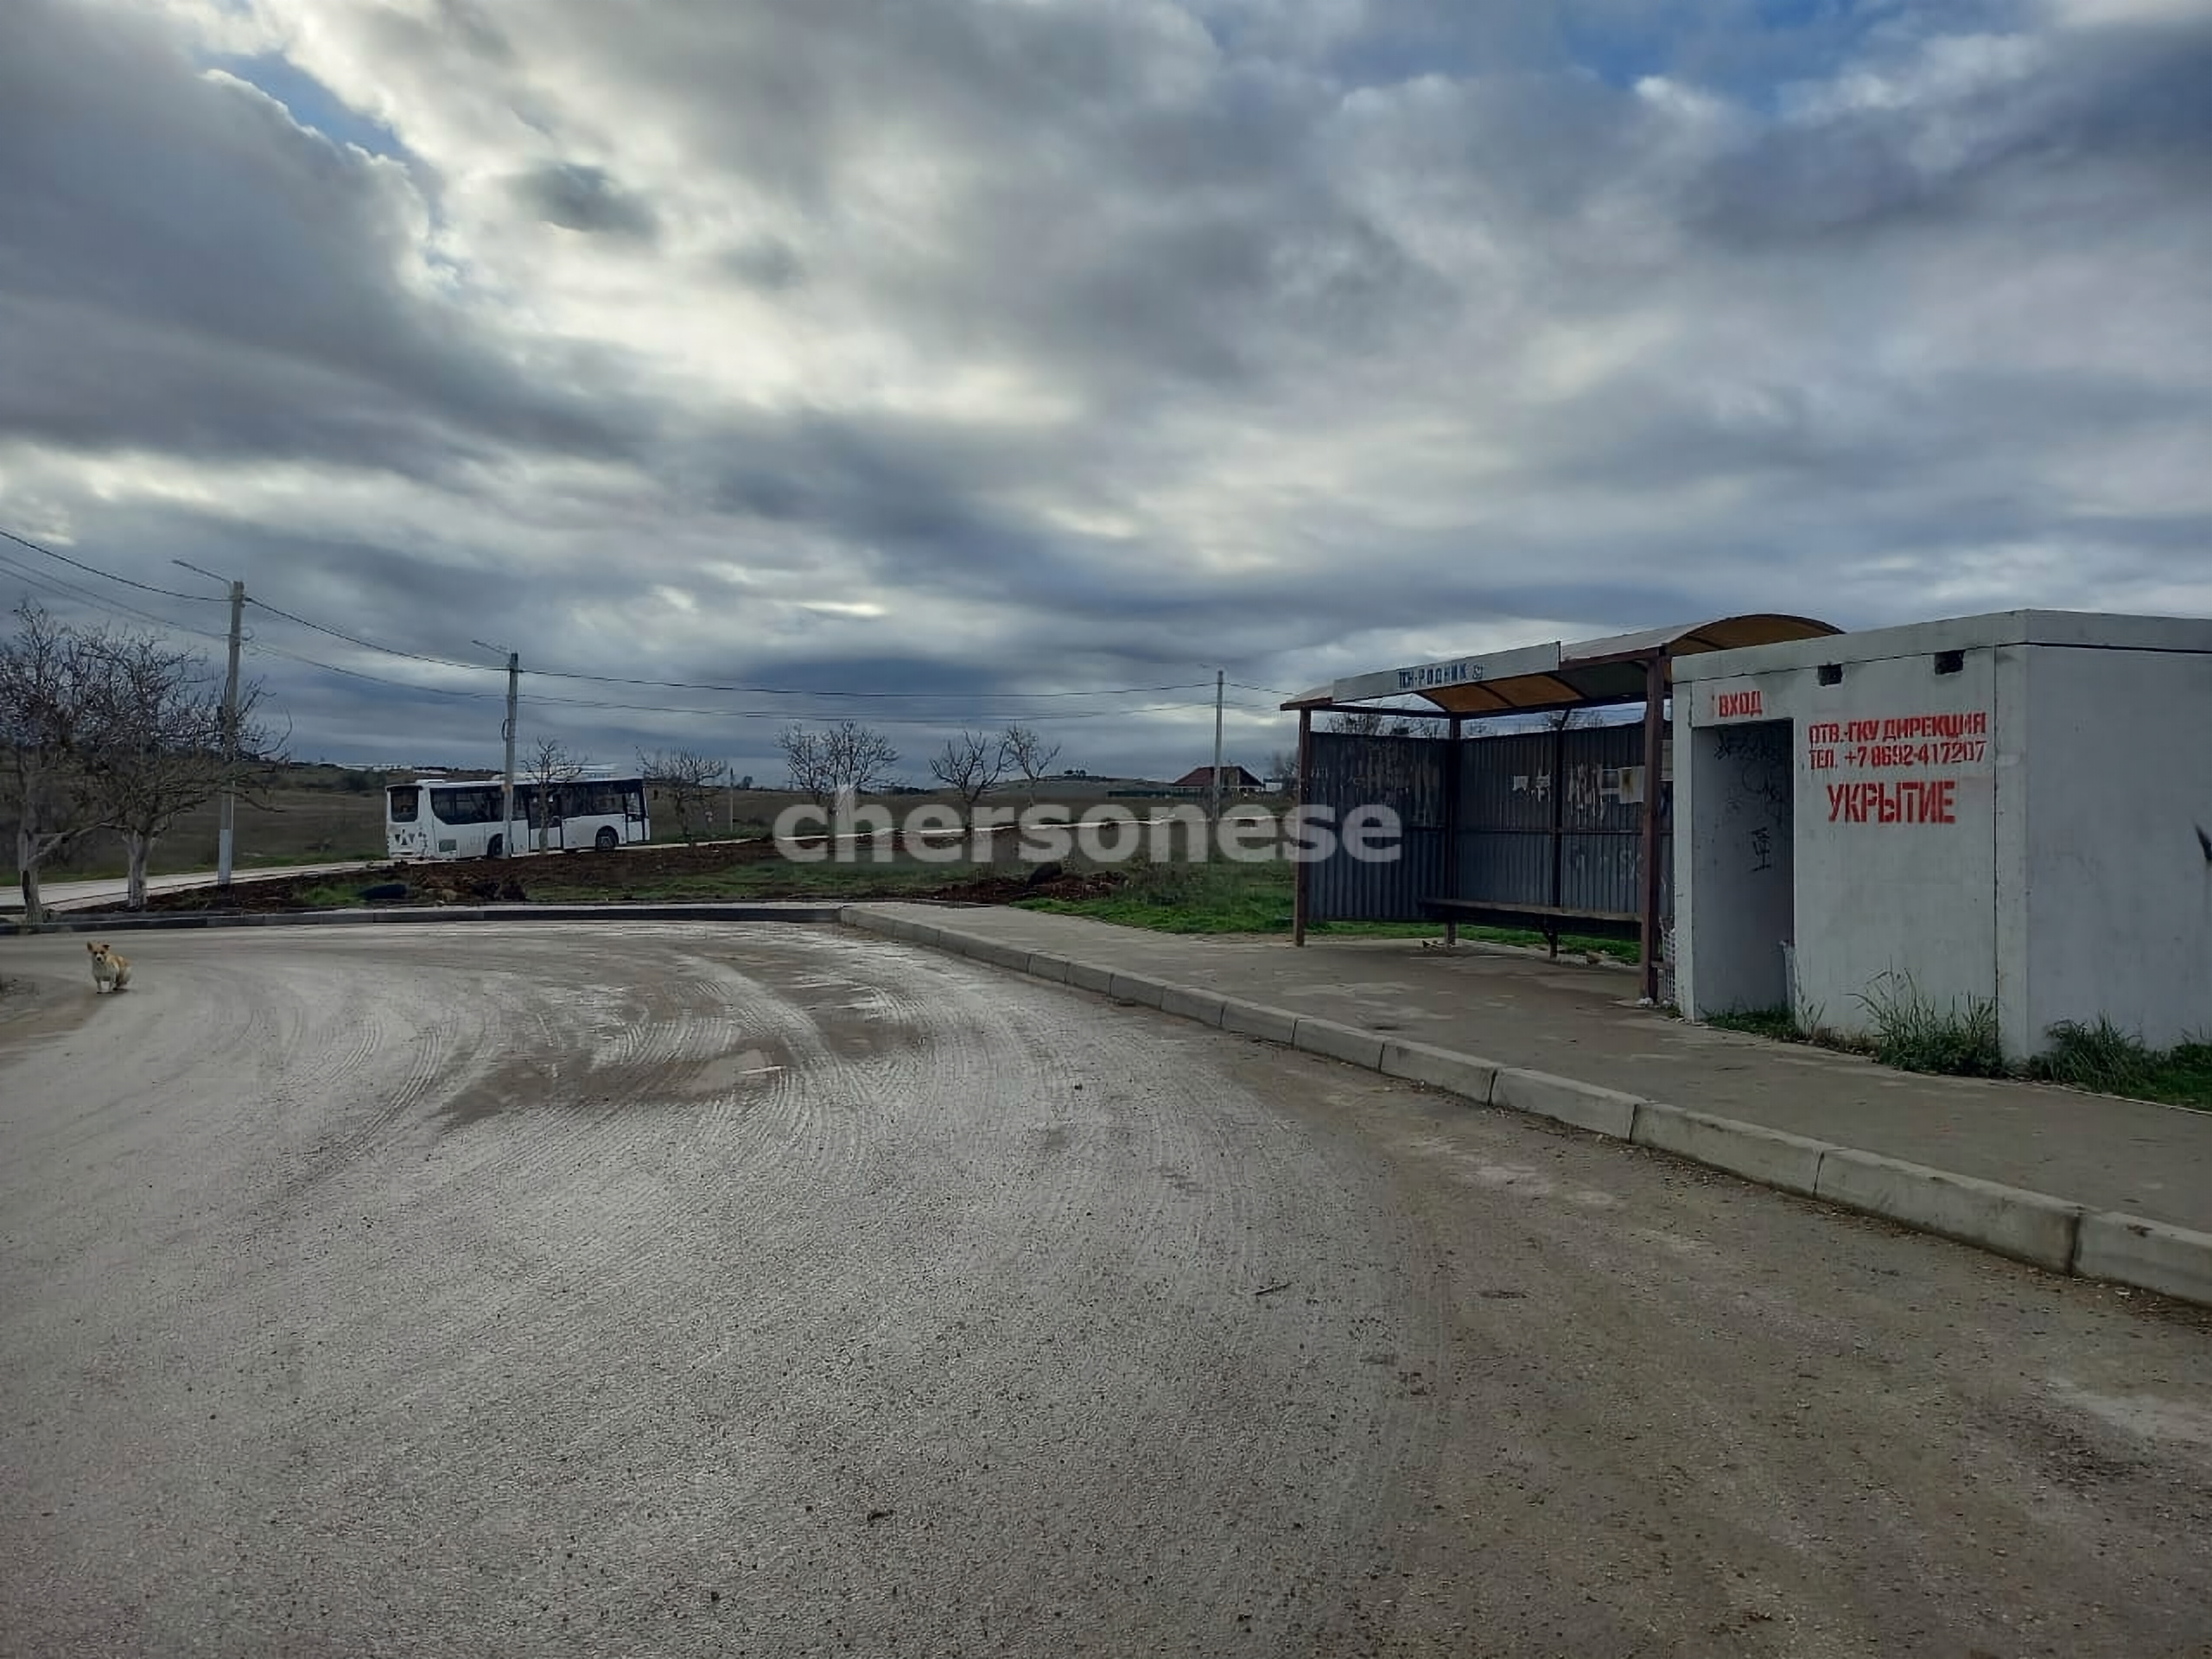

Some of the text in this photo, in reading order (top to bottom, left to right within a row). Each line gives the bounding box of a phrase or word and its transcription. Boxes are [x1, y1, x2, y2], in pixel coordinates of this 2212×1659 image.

[1719, 691, 1763, 717] ВХОД
[1883, 712, 1986, 741] ДИРЕКЦИЯ
[1809, 749, 1838, 770] ТЕЛ.
[1827, 780, 1956, 824] УКРЫТИЕ
